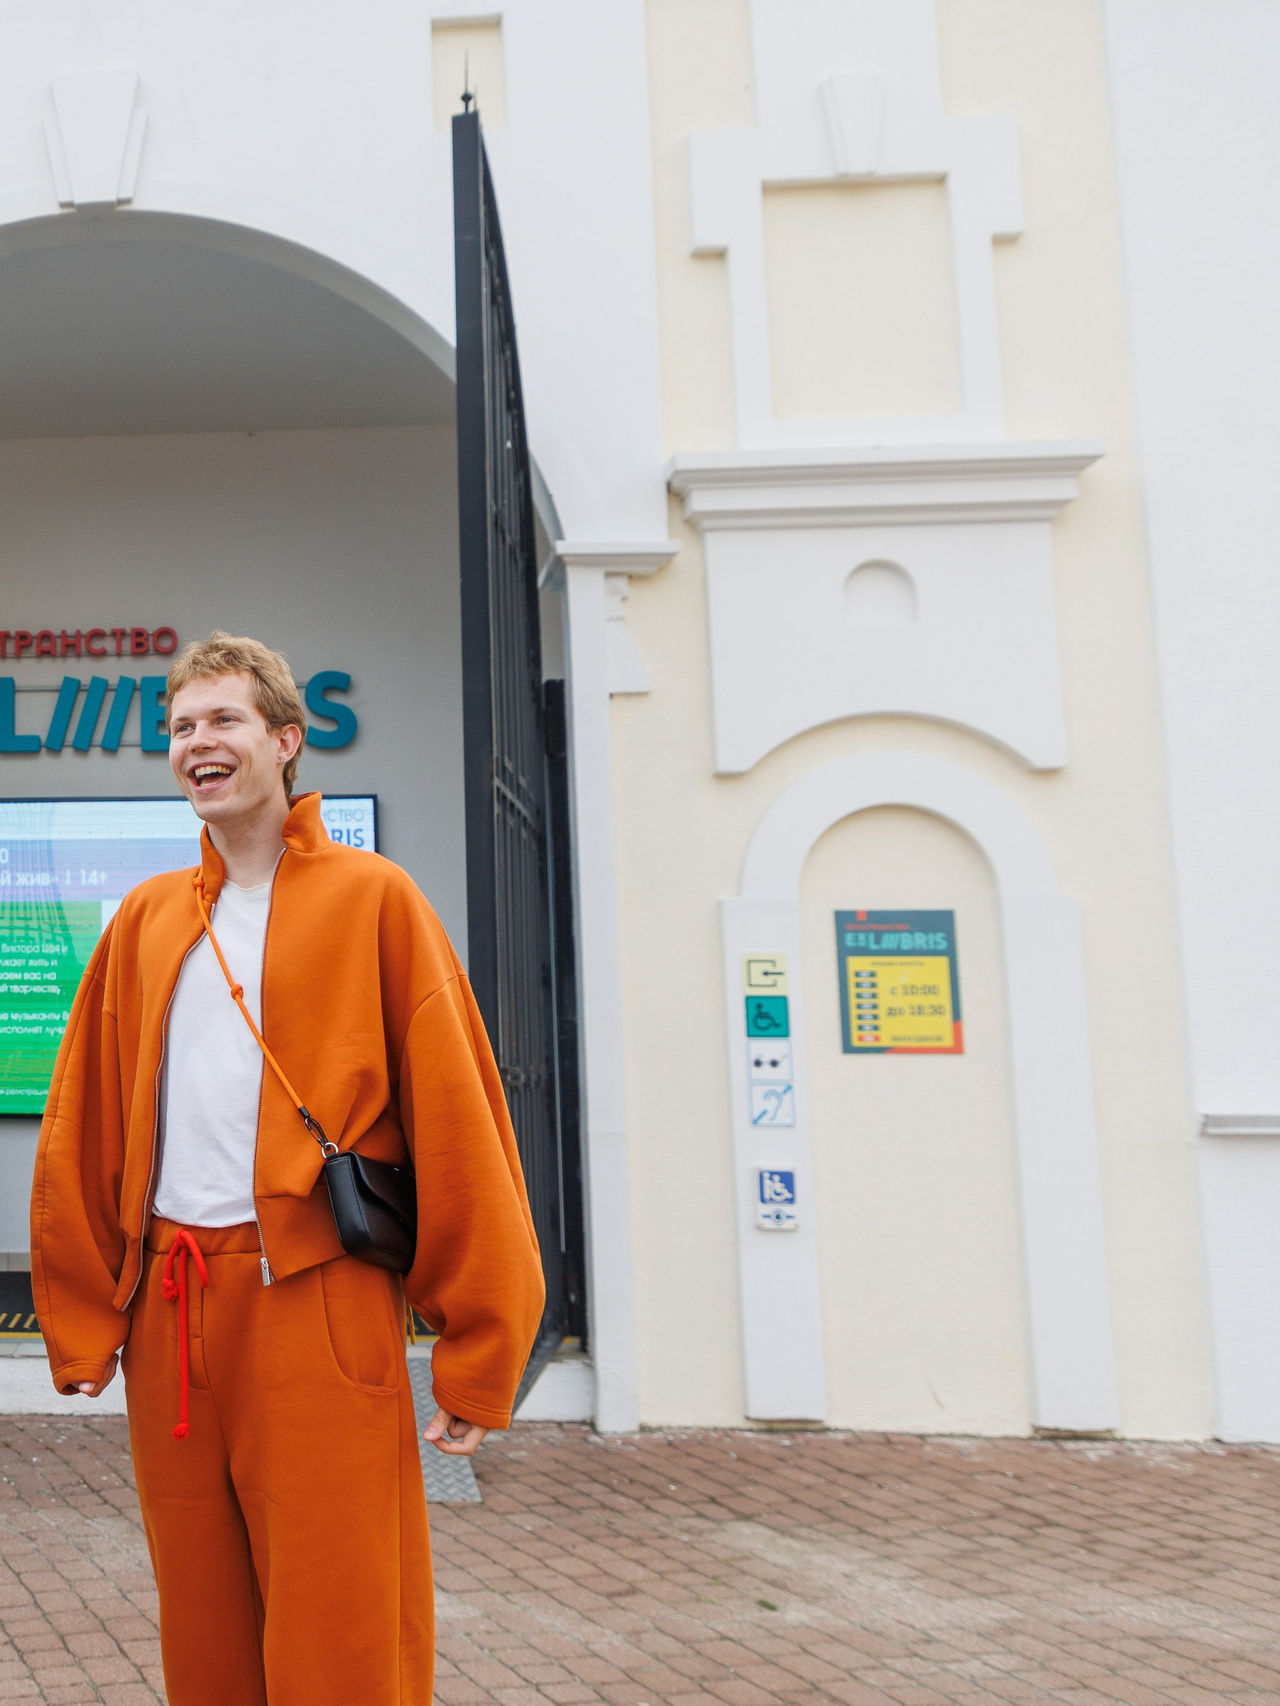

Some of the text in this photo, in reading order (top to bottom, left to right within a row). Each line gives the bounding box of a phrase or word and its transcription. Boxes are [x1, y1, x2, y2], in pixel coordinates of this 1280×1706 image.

[16, 872, 59, 887] жив»
[79, 868, 109, 885] 14+
[23, 971, 42, 981] вас
[43, 971, 57, 981] на
